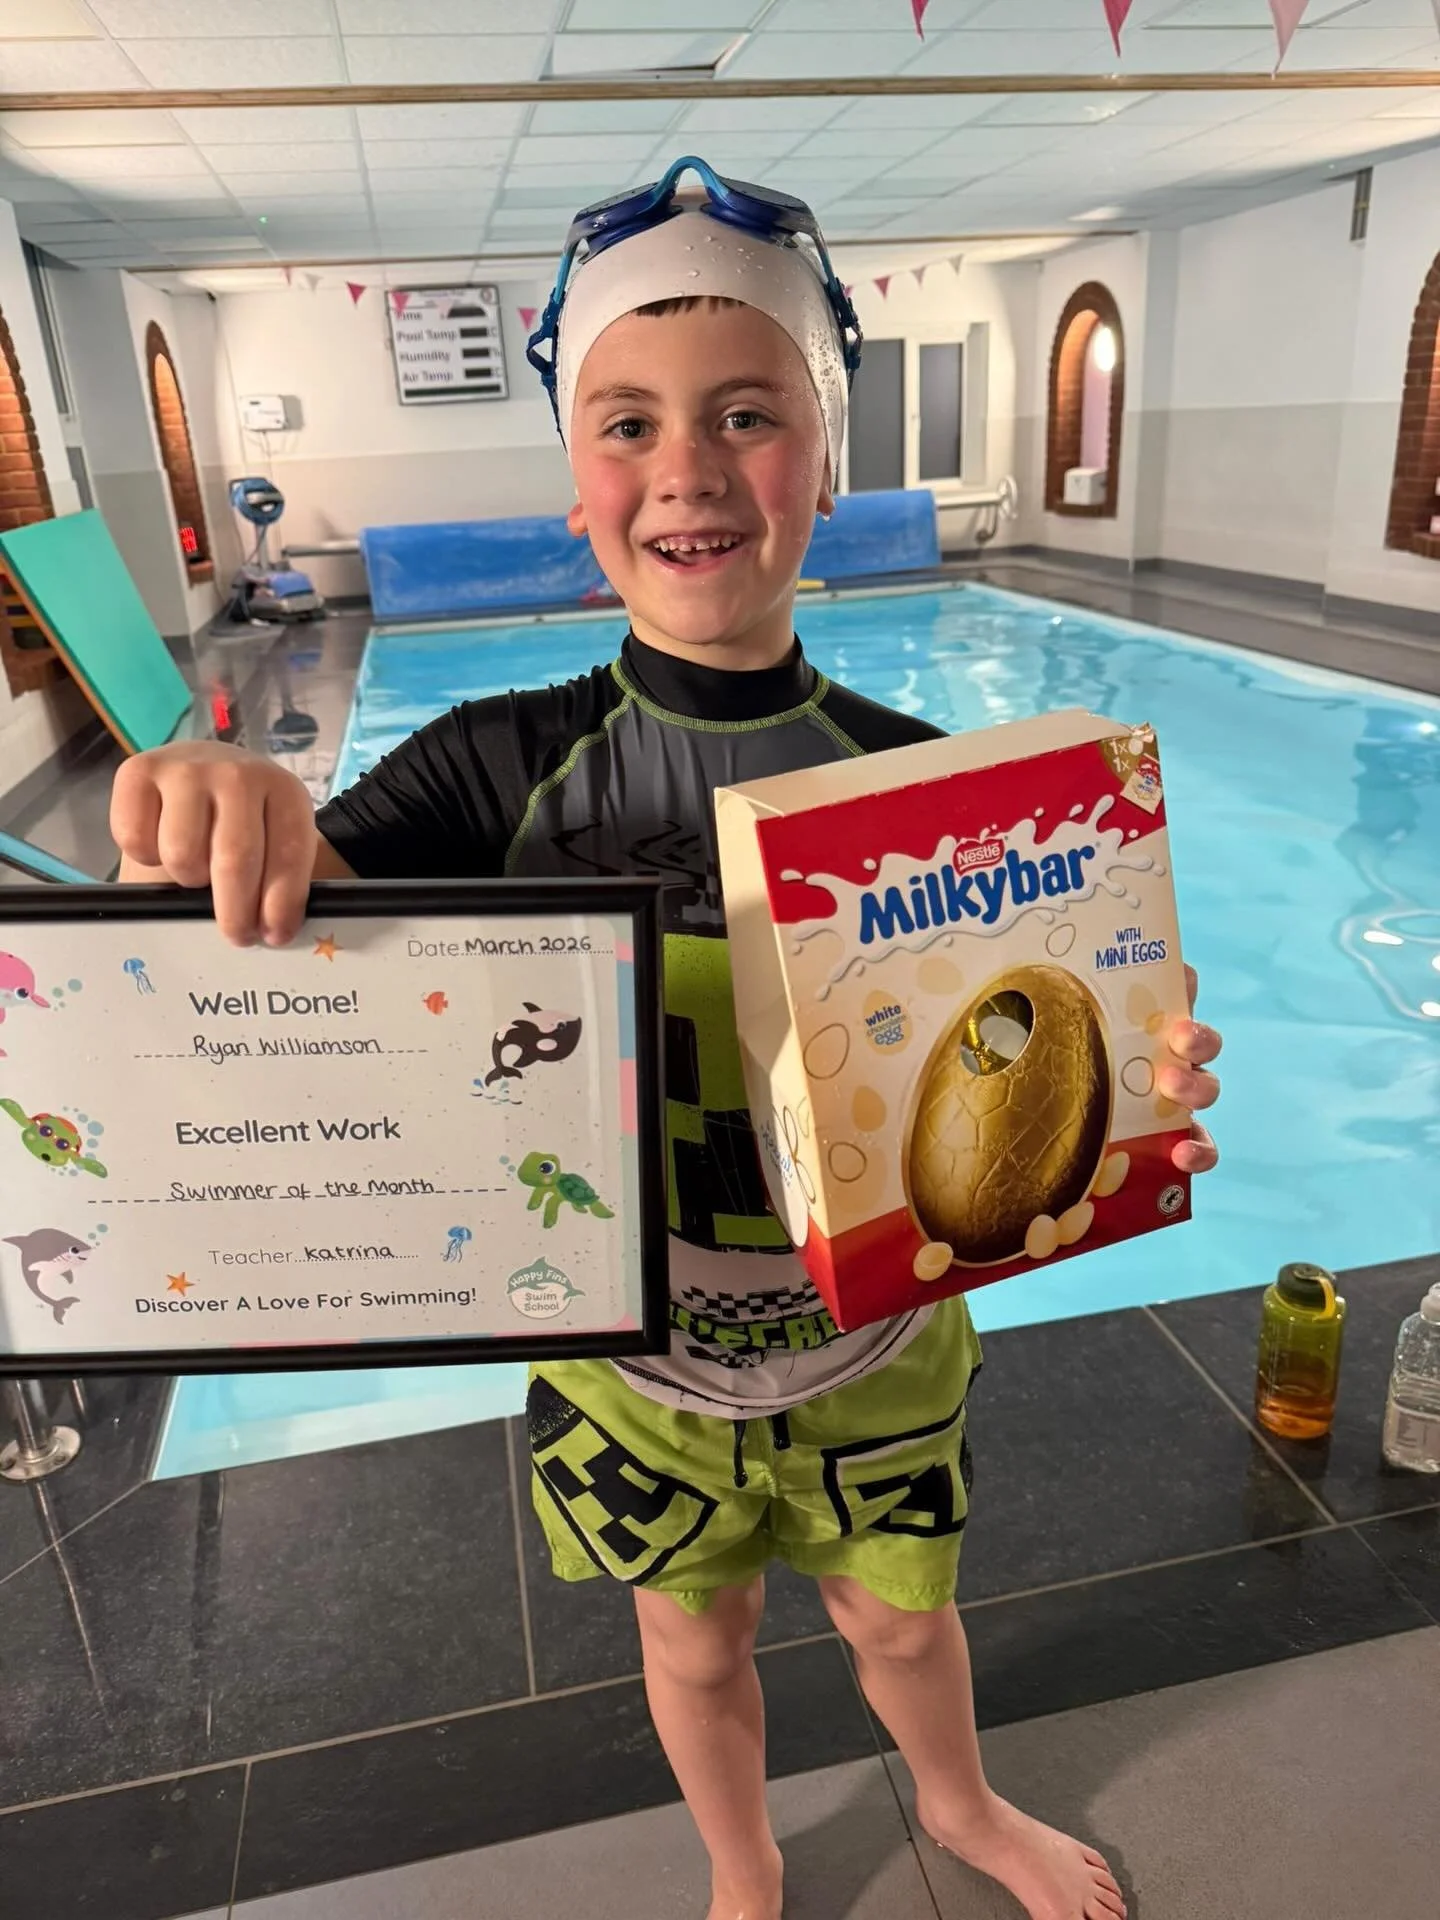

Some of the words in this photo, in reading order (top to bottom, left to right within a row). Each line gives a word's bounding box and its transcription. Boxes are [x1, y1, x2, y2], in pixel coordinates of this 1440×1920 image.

[397, 331, 424, 342] Pool
[425, 329, 457, 341] Temp
[400, 351, 450, 363] Humidity
[402, 371, 419, 383] Air
[421, 370, 453, 382] Temp
[860, 844, 1095, 945] Milkybar
[407, 938, 459, 957] Date
[464, 937, 534, 955] March
[539, 936, 592, 951] 2026
[1132, 939, 1167, 964] EGGS
[188, 990, 259, 1017] Well
[266, 990, 359, 1016] Done!
[865, 1004, 902, 1027] white
[874, 1023, 905, 1046] egg
[192, 1035, 251, 1065] Ryan
[258, 1038, 382, 1056] Williamson
[175, 1119, 312, 1145] Excellent
[316, 1116, 402, 1141] Work
[170, 1182, 279, 1202] Swimmer
[286, 1183, 312, 1200] of
[324, 1180, 362, 1198] the
[367, 1178, 435, 1196] Month
[208, 1248, 294, 1265] Teacher
[510, 1271, 544, 1288] Happy
[546, 1269, 568, 1284] Fins
[135, 1297, 229, 1314] Discover
[236, 1296, 252, 1312] A
[257, 1295, 310, 1311] Love
[317, 1292, 354, 1309] For
[360, 1286, 477, 1309] Swimming!
[524, 1302, 560, 1312] School
[525, 1292, 558, 1301] Swim
